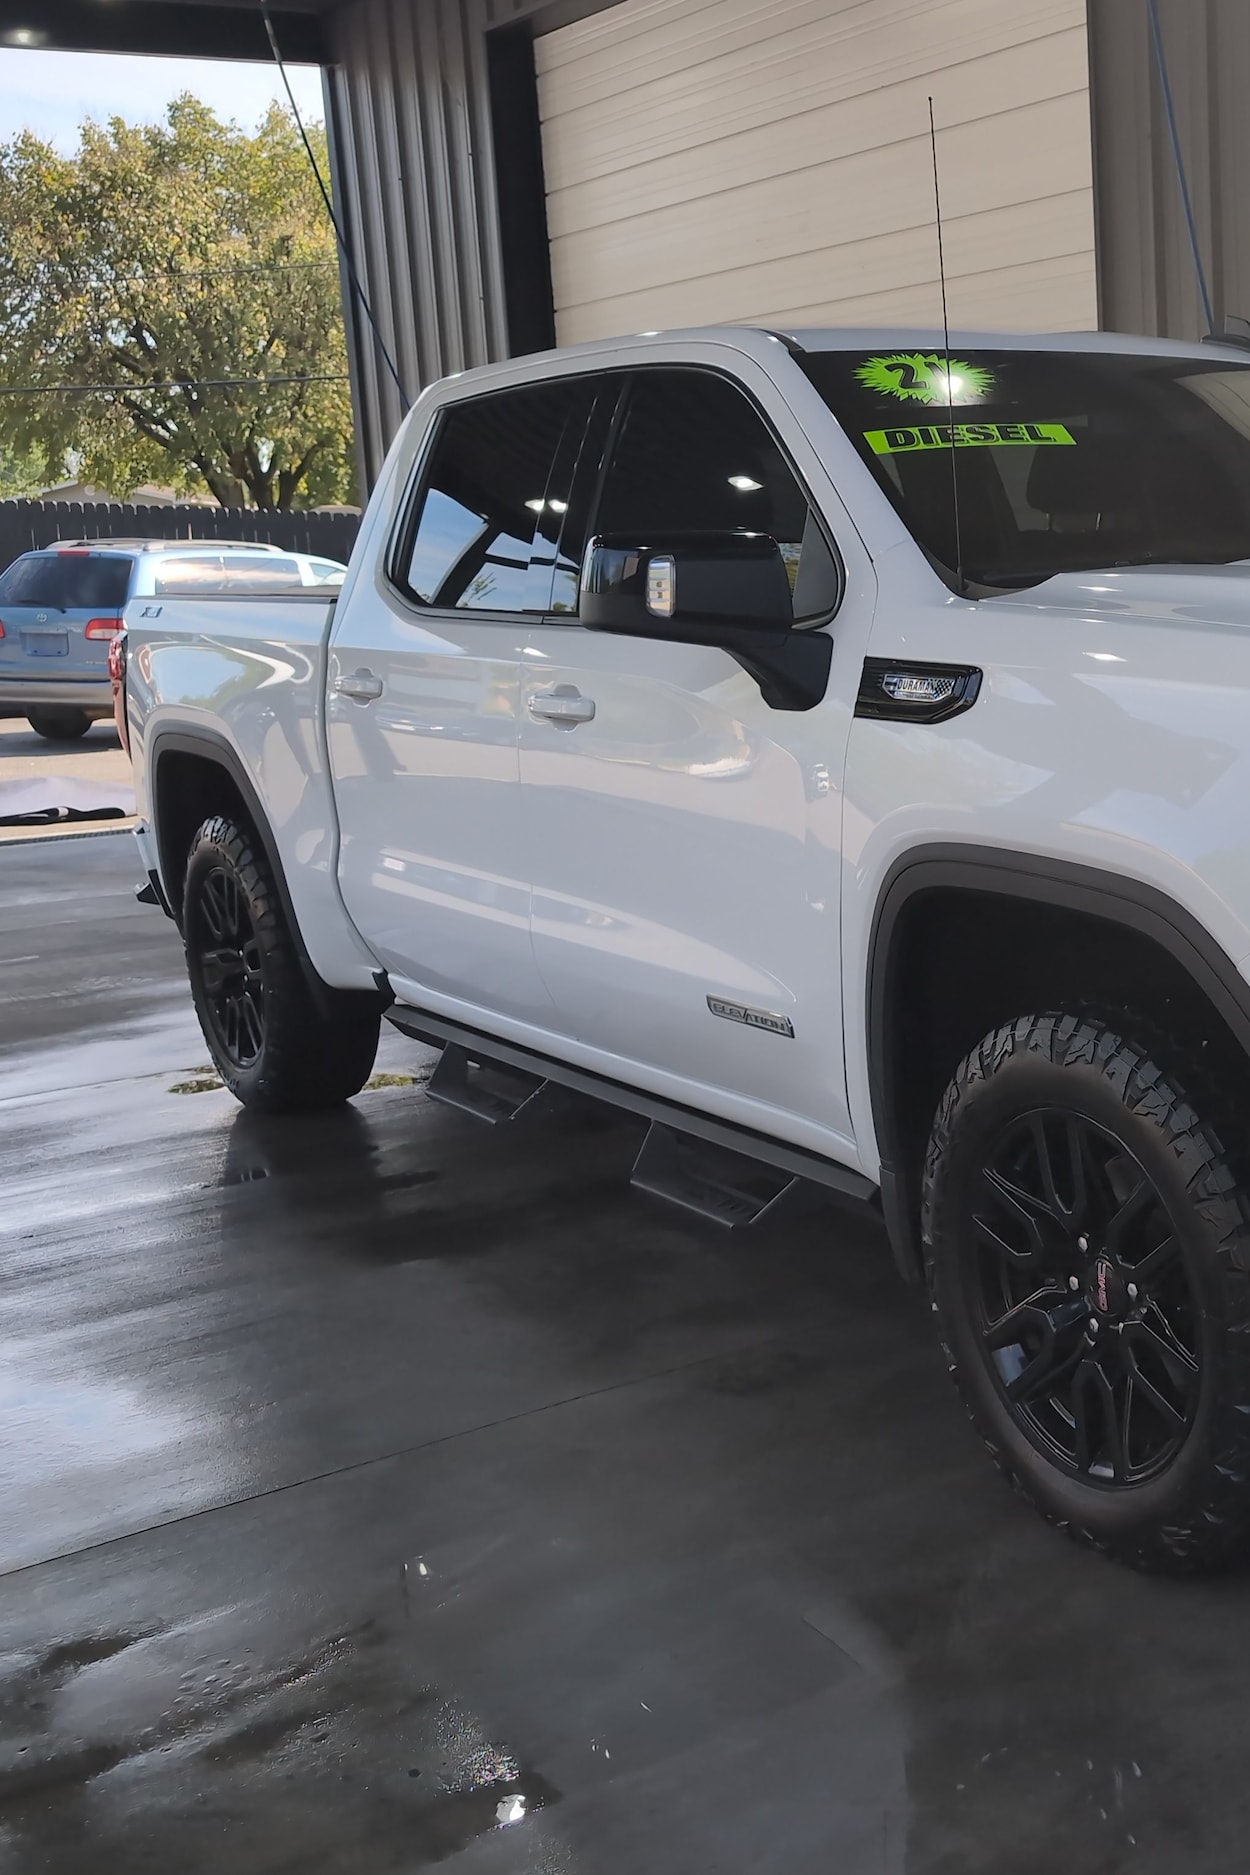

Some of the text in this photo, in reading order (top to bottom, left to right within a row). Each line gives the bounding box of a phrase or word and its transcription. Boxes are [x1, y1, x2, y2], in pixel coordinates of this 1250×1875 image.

[884, 424, 1056, 448] DIESEL
[713, 1003, 785, 1031] ELEVATION
[1097, 1262, 1108, 1312] GMC
